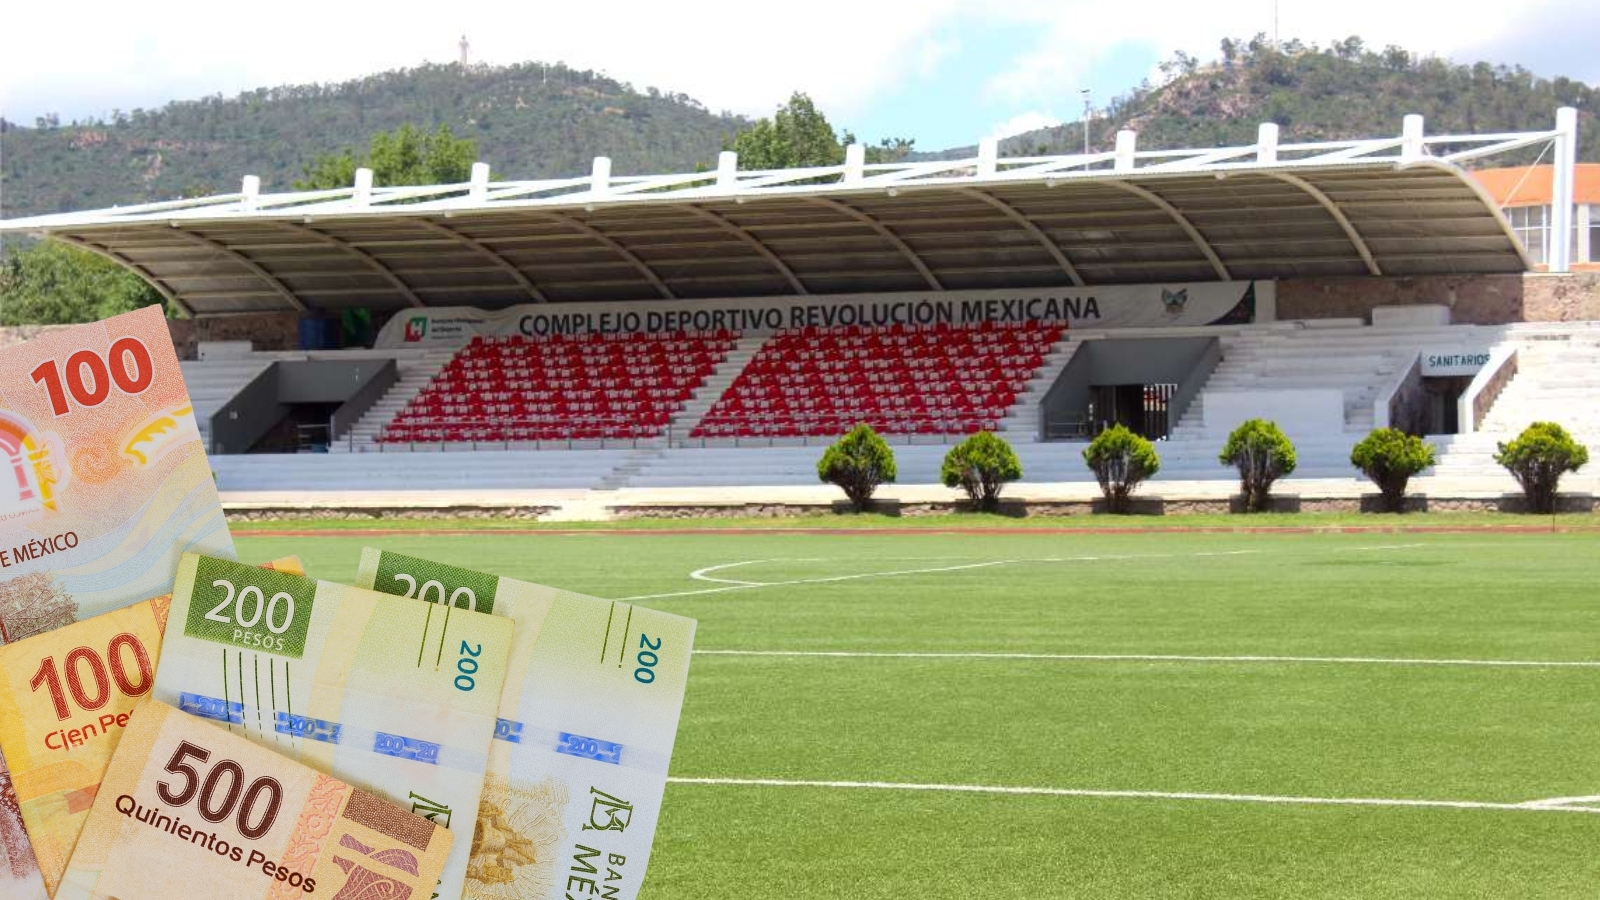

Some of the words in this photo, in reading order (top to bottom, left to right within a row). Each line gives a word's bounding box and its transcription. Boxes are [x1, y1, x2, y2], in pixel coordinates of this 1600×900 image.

[519, 312, 640, 336] COMPLEJO
[647, 307, 782, 333] DEPORTIVO
[790, 299, 953, 327] REVOLUCIÓN
[961, 297, 1101, 321] MEXICANA
[30, 337, 153, 417] 100
[13, 531, 78, 564] MÉXICO
[204, 579, 295, 634] 200
[233, 629, 284, 651] PESOS
[453, 640, 482, 692] 200
[633, 633, 662, 684] 200
[29, 632, 154, 721] 100
[198, 697, 228, 717] 200
[44, 723, 98, 751] Cien
[156, 740, 283, 840] 500
[115, 794, 244, 862] Quinientos
[246, 849, 317, 893] Pesos
[565, 843, 602, 900] MÉ
